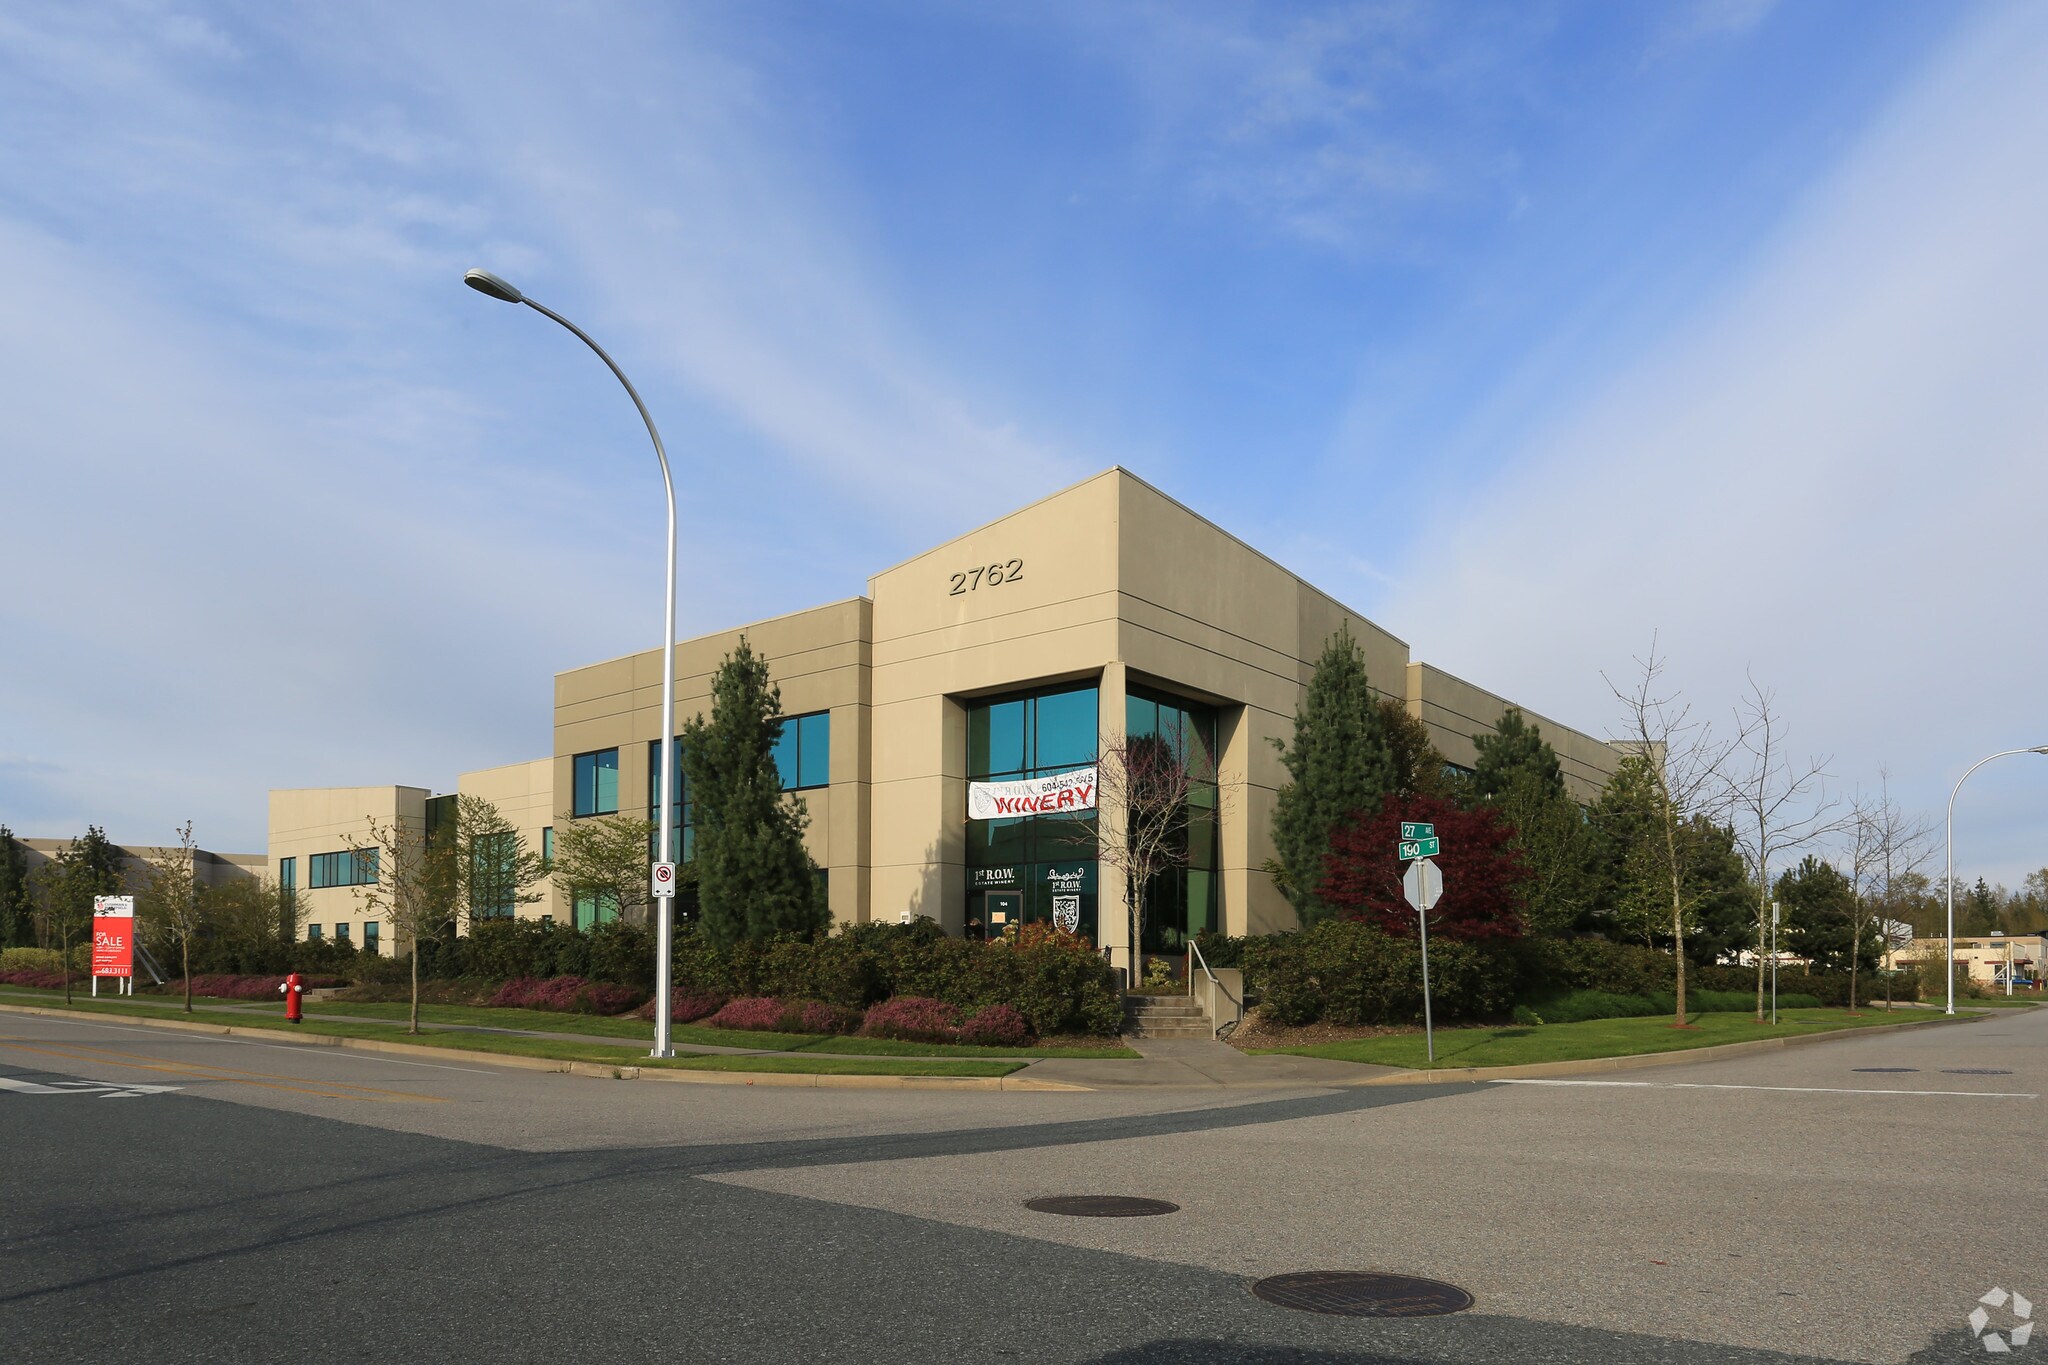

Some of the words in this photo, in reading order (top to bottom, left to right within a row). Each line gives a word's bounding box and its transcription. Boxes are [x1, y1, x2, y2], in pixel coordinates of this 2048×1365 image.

[949, 558, 1023, 596] 2762
[992, 785, 1093, 815] WINERY
[1404, 825, 1415, 838] 27
[1402, 843, 1420, 857] 190
[1429, 841, 1435, 849] ST
[975, 869, 985, 880] 1st
[986, 868, 1015, 880] R.O.W.
[96, 936, 123, 946] SALE
